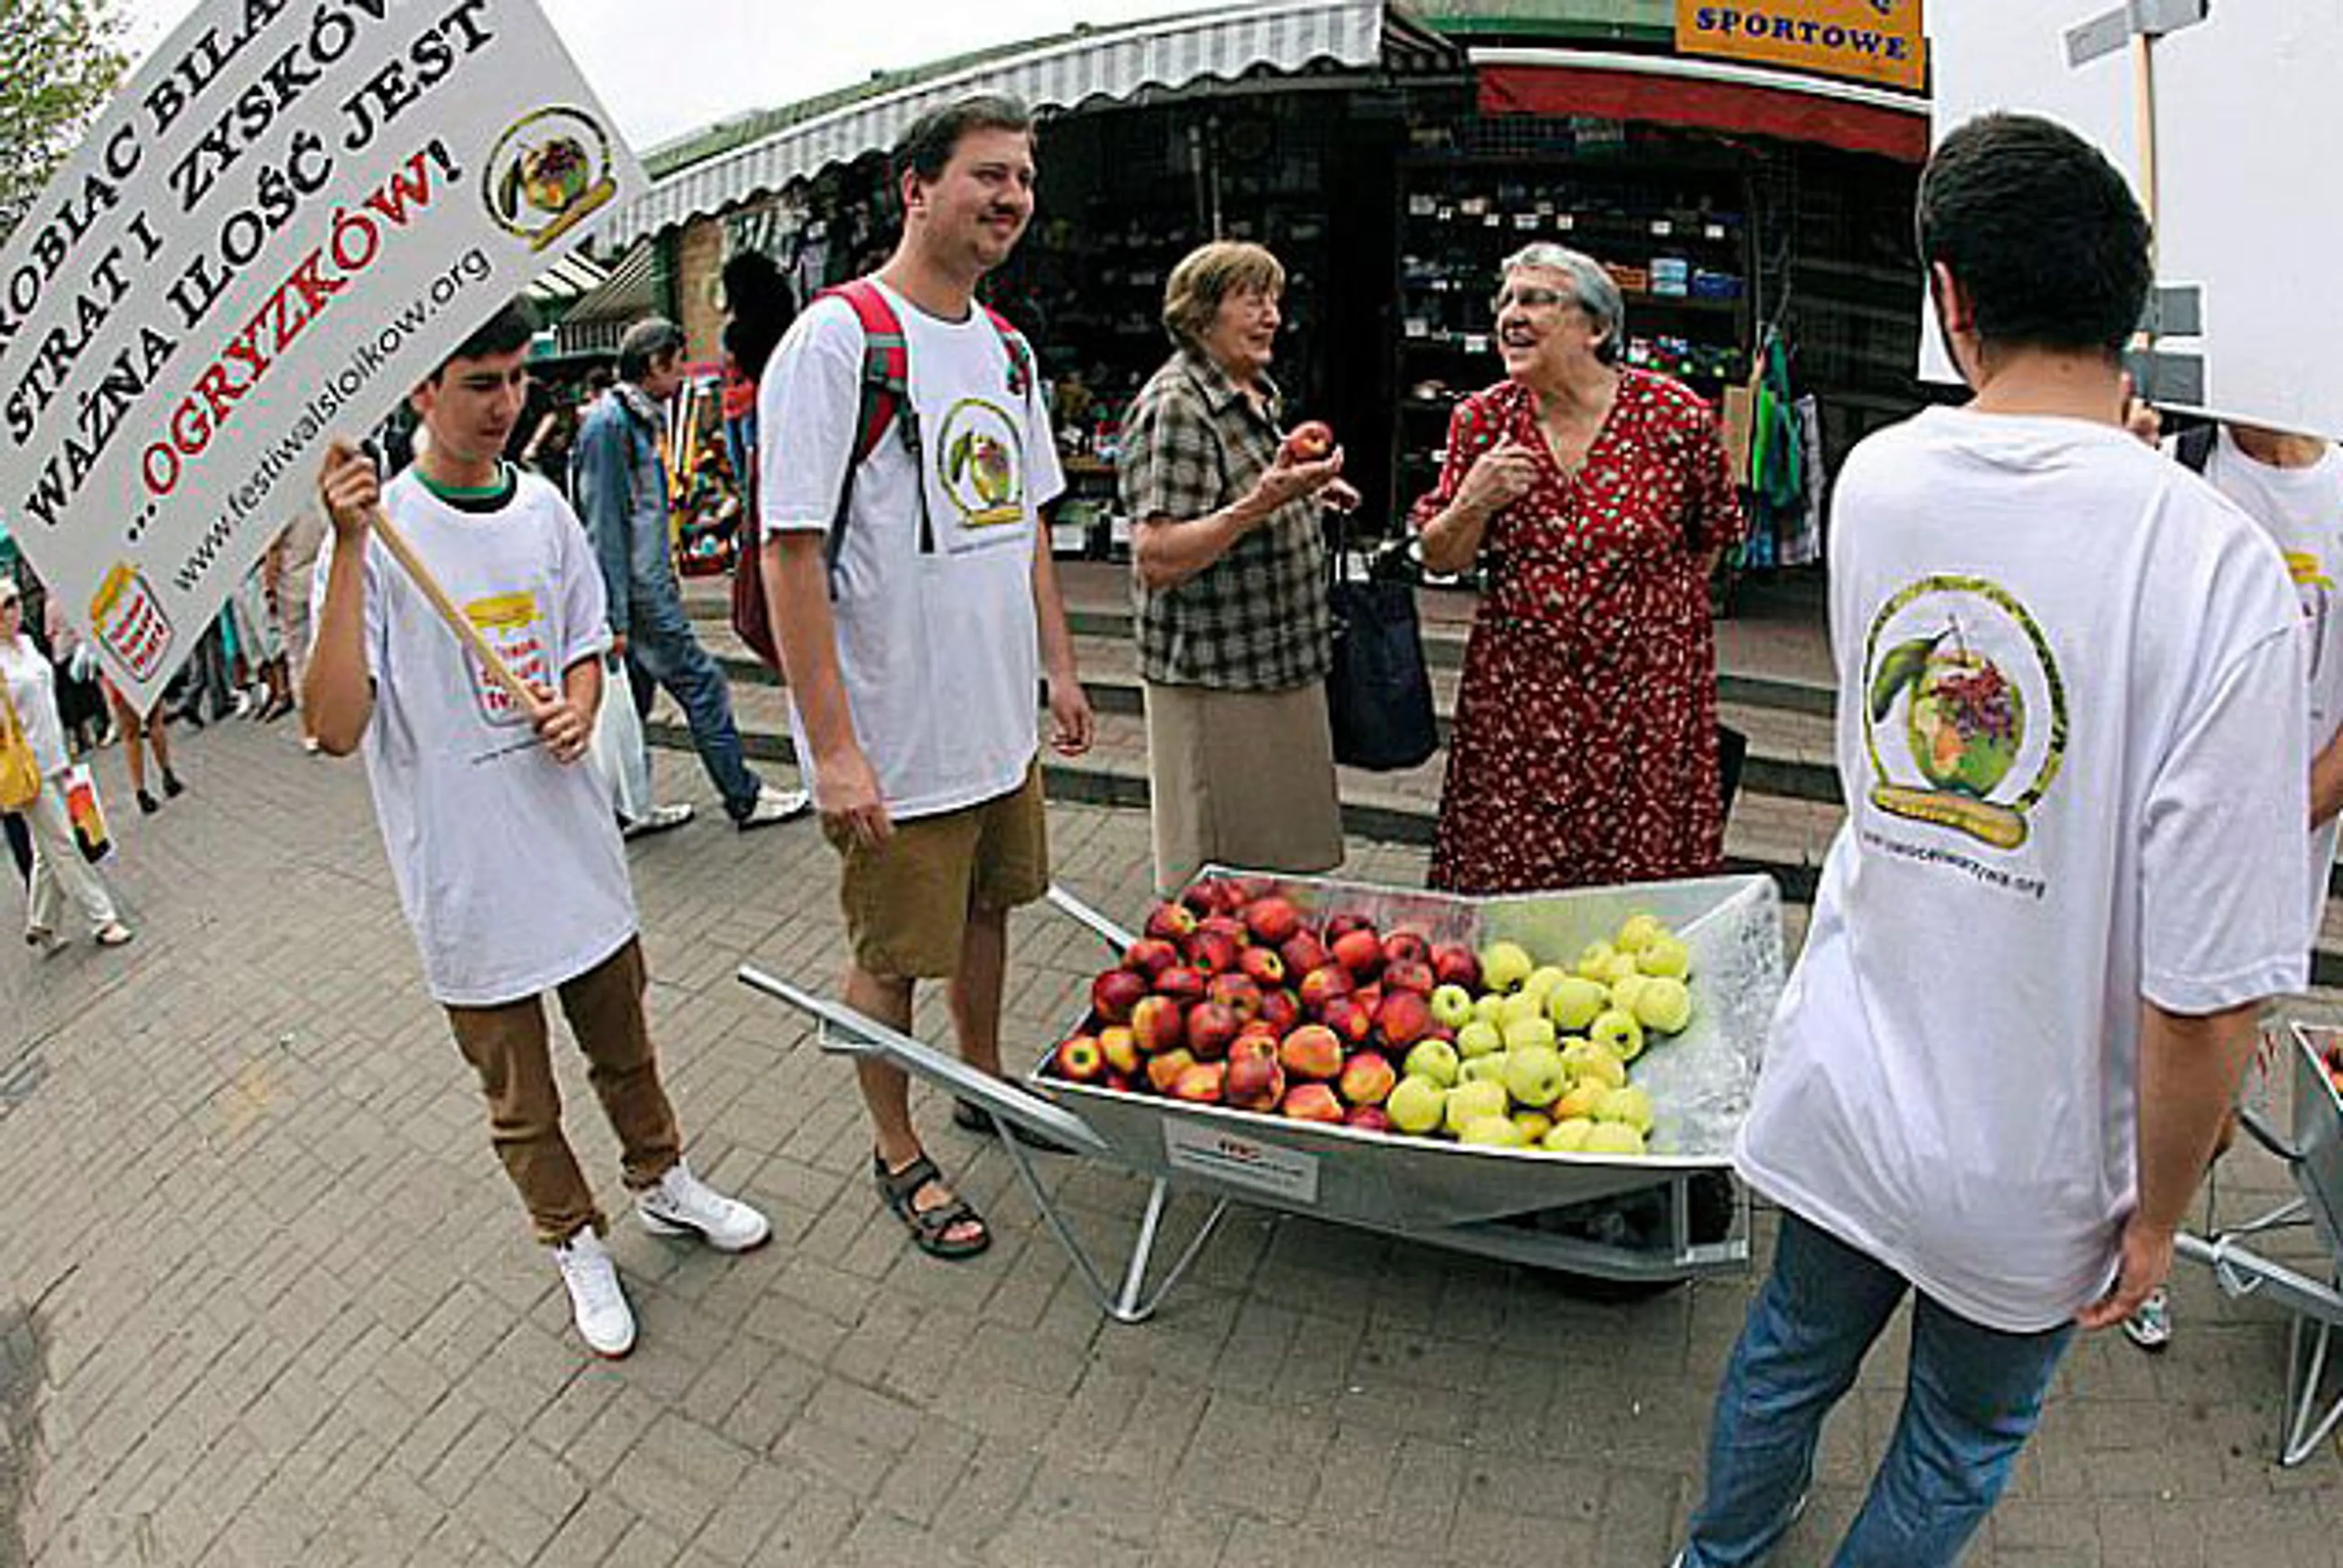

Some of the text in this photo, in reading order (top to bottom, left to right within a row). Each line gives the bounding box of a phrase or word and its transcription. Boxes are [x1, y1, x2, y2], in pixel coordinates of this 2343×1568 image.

[1696, 7, 1909, 59] SPORTOWE
[6, 246, 130, 445] STRAT
[127, 210, 163, 261] I
[25, 0, 493, 526] WAŻNA ILOŚĆ JEST
[128, 139, 462, 542] ...OGRYZKÓW!
[173, 248, 491, 592] www.festiwalsloikow.org
